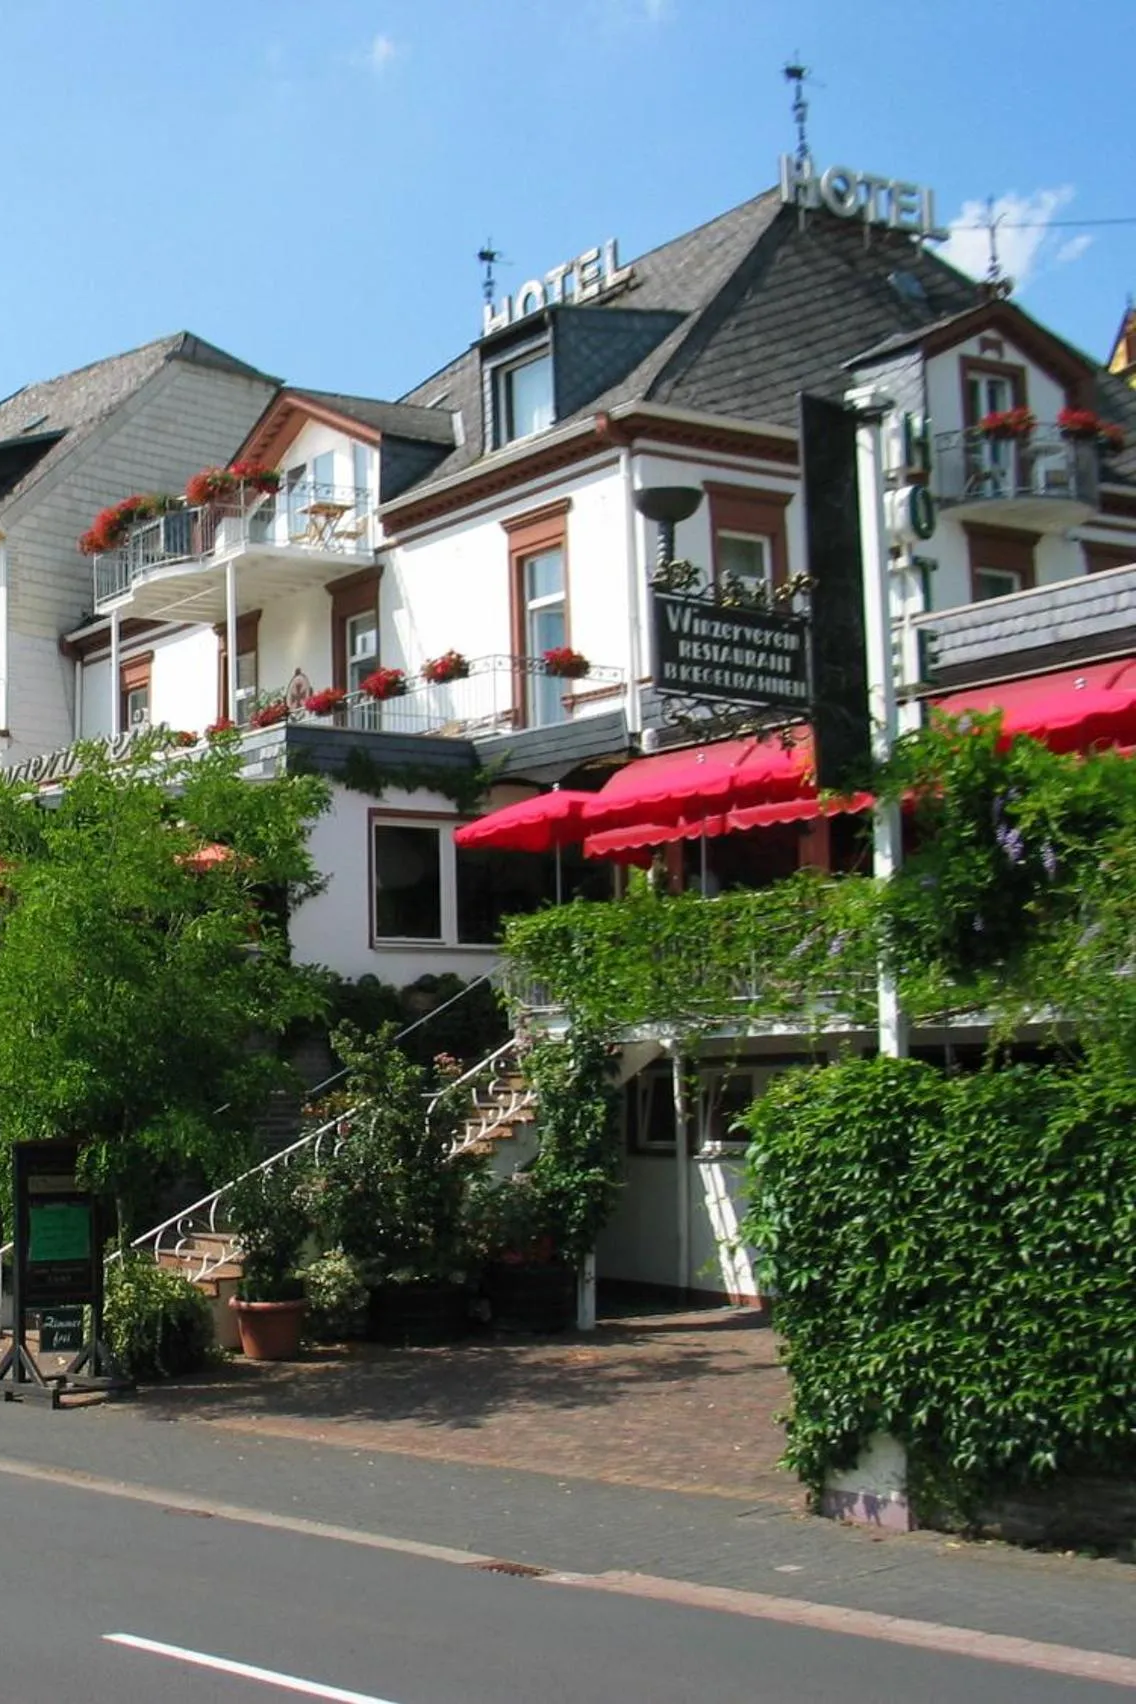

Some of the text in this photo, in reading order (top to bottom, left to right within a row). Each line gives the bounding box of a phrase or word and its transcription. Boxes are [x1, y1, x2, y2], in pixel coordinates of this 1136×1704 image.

[779, 153, 951, 238] HOTEL
[483, 238, 632, 337] HOTEL
[666, 603, 800, 650] Winzerverein
[678, 639, 791, 673] RESTAURANT
